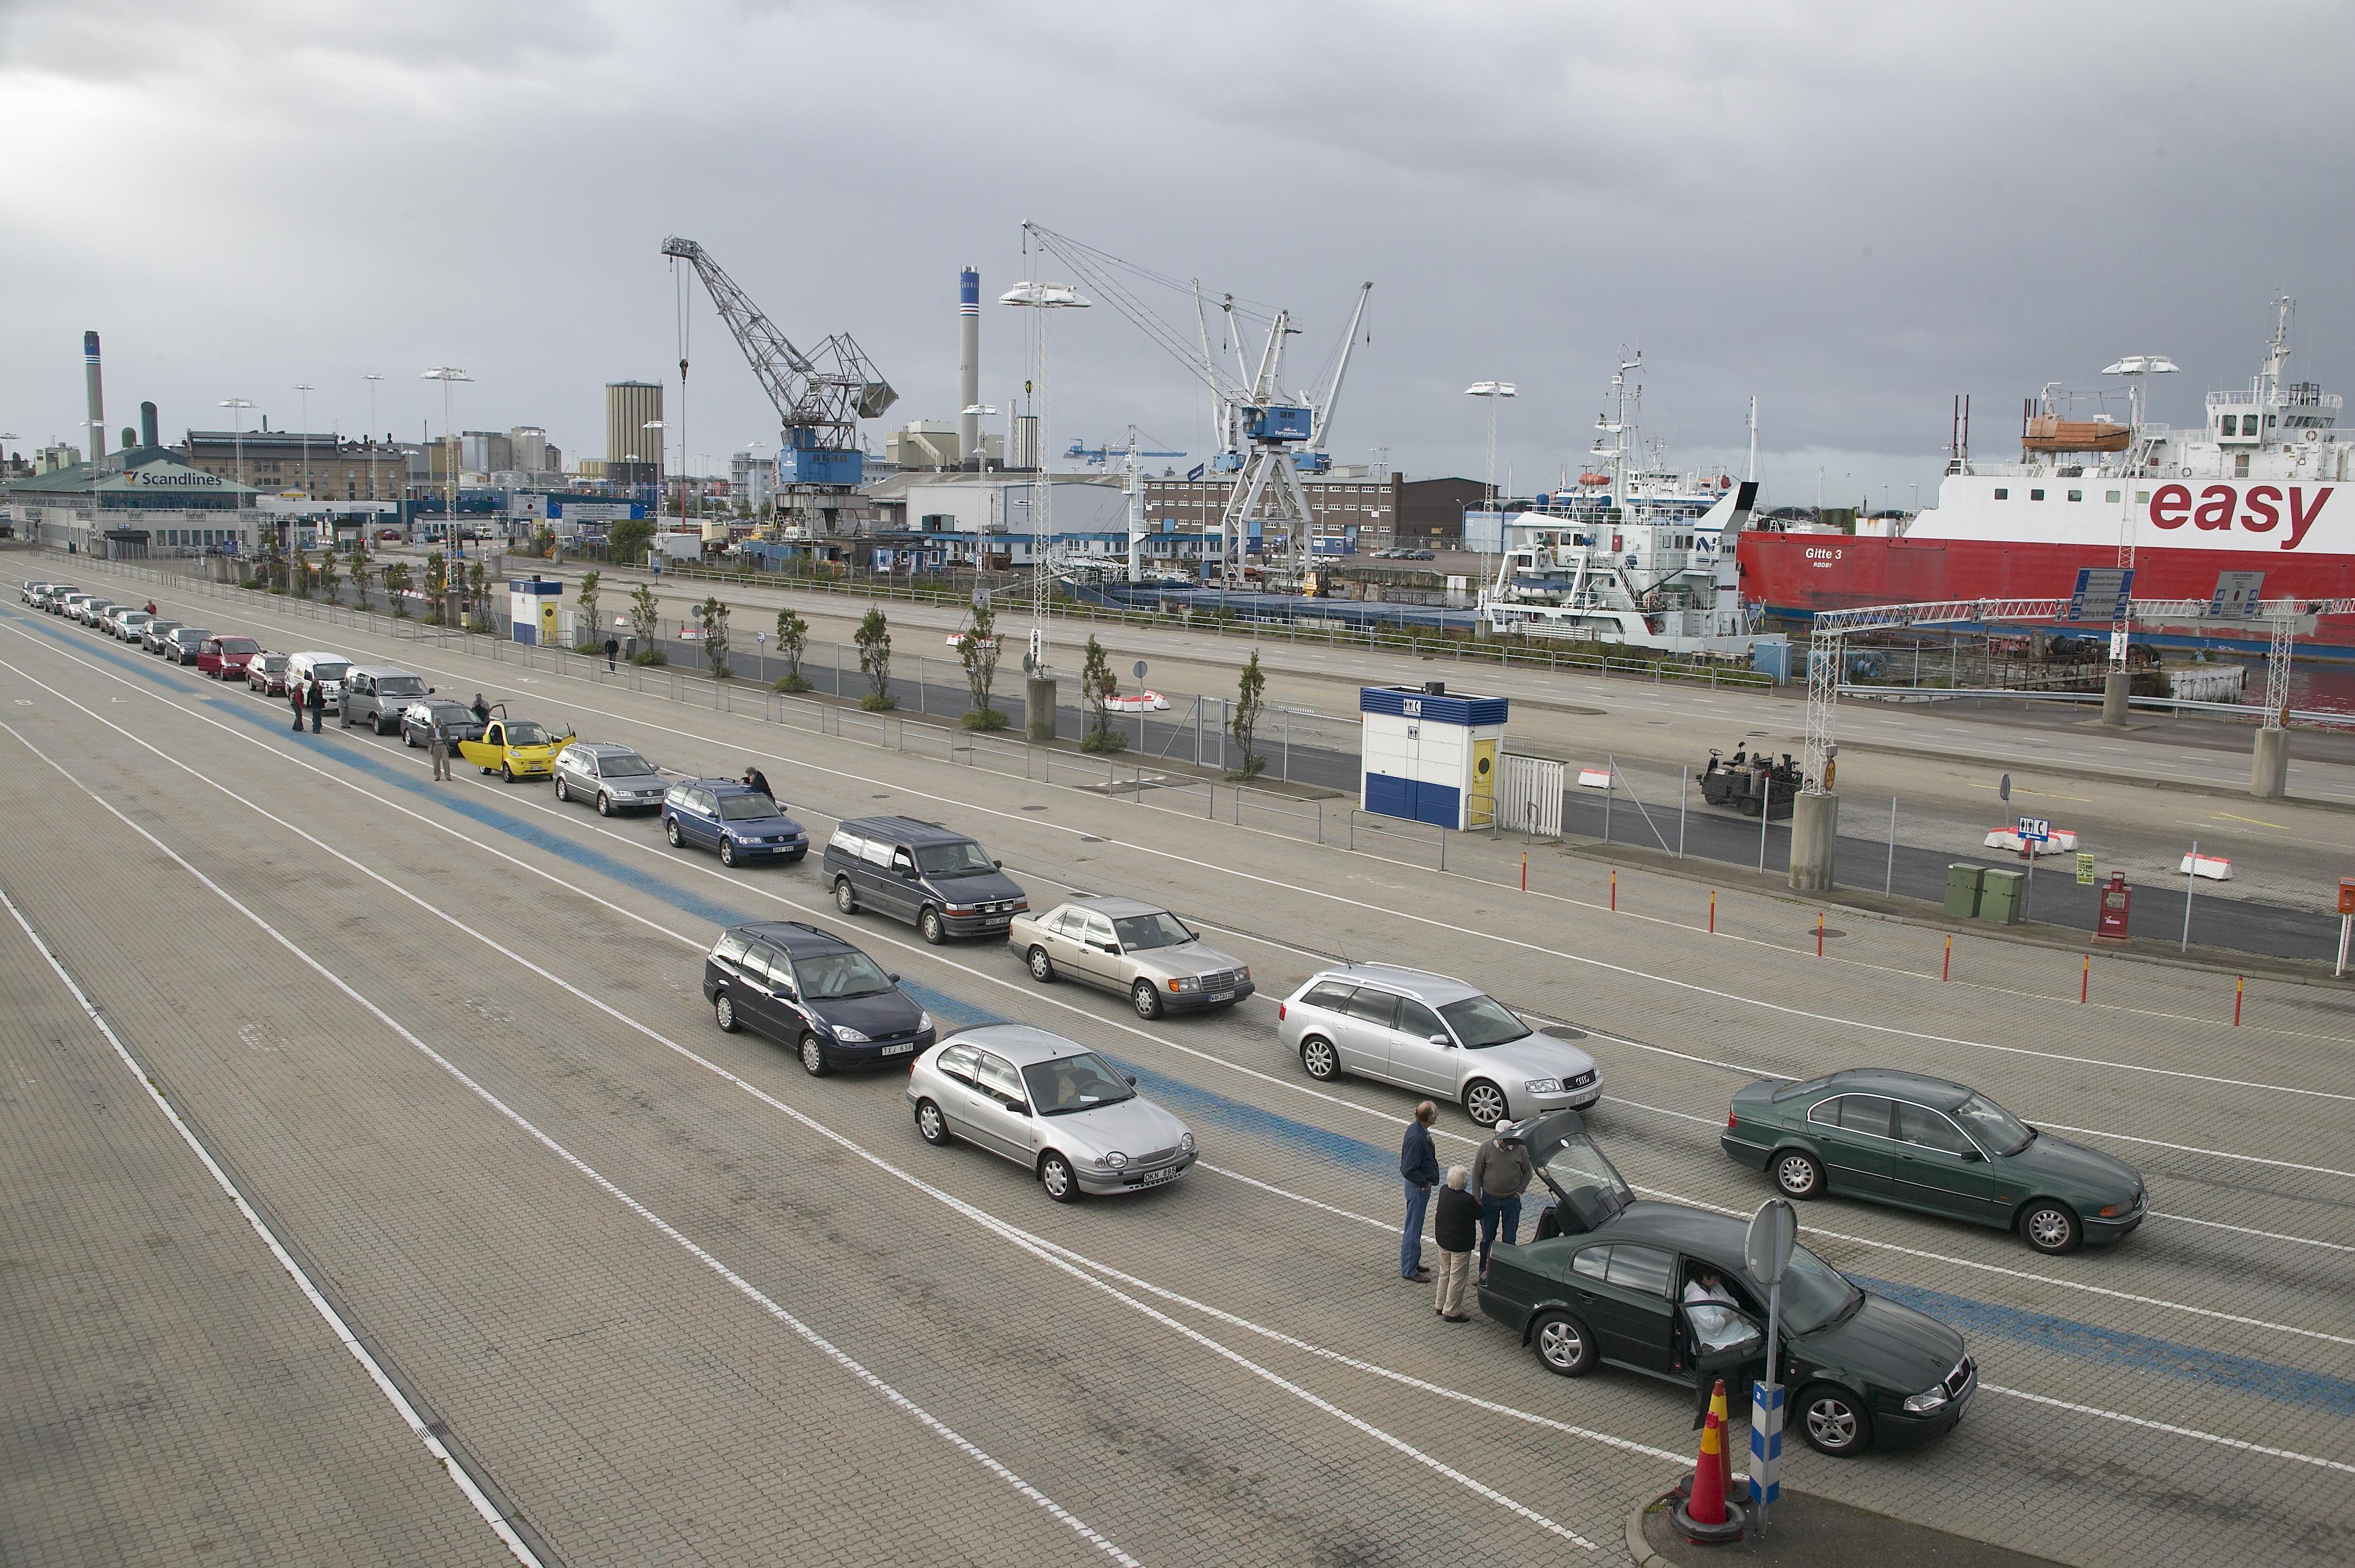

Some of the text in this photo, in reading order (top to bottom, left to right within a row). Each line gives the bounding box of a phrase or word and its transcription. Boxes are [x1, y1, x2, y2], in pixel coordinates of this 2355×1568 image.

[142, 472, 223, 486] Scandlines
[2150, 484, 2335, 549] easy
[1806, 548, 1842, 560] Gitte 3
[1827, 767, 1834, 782] 30
[1145, 1167, 1176, 1181] OKN 895
